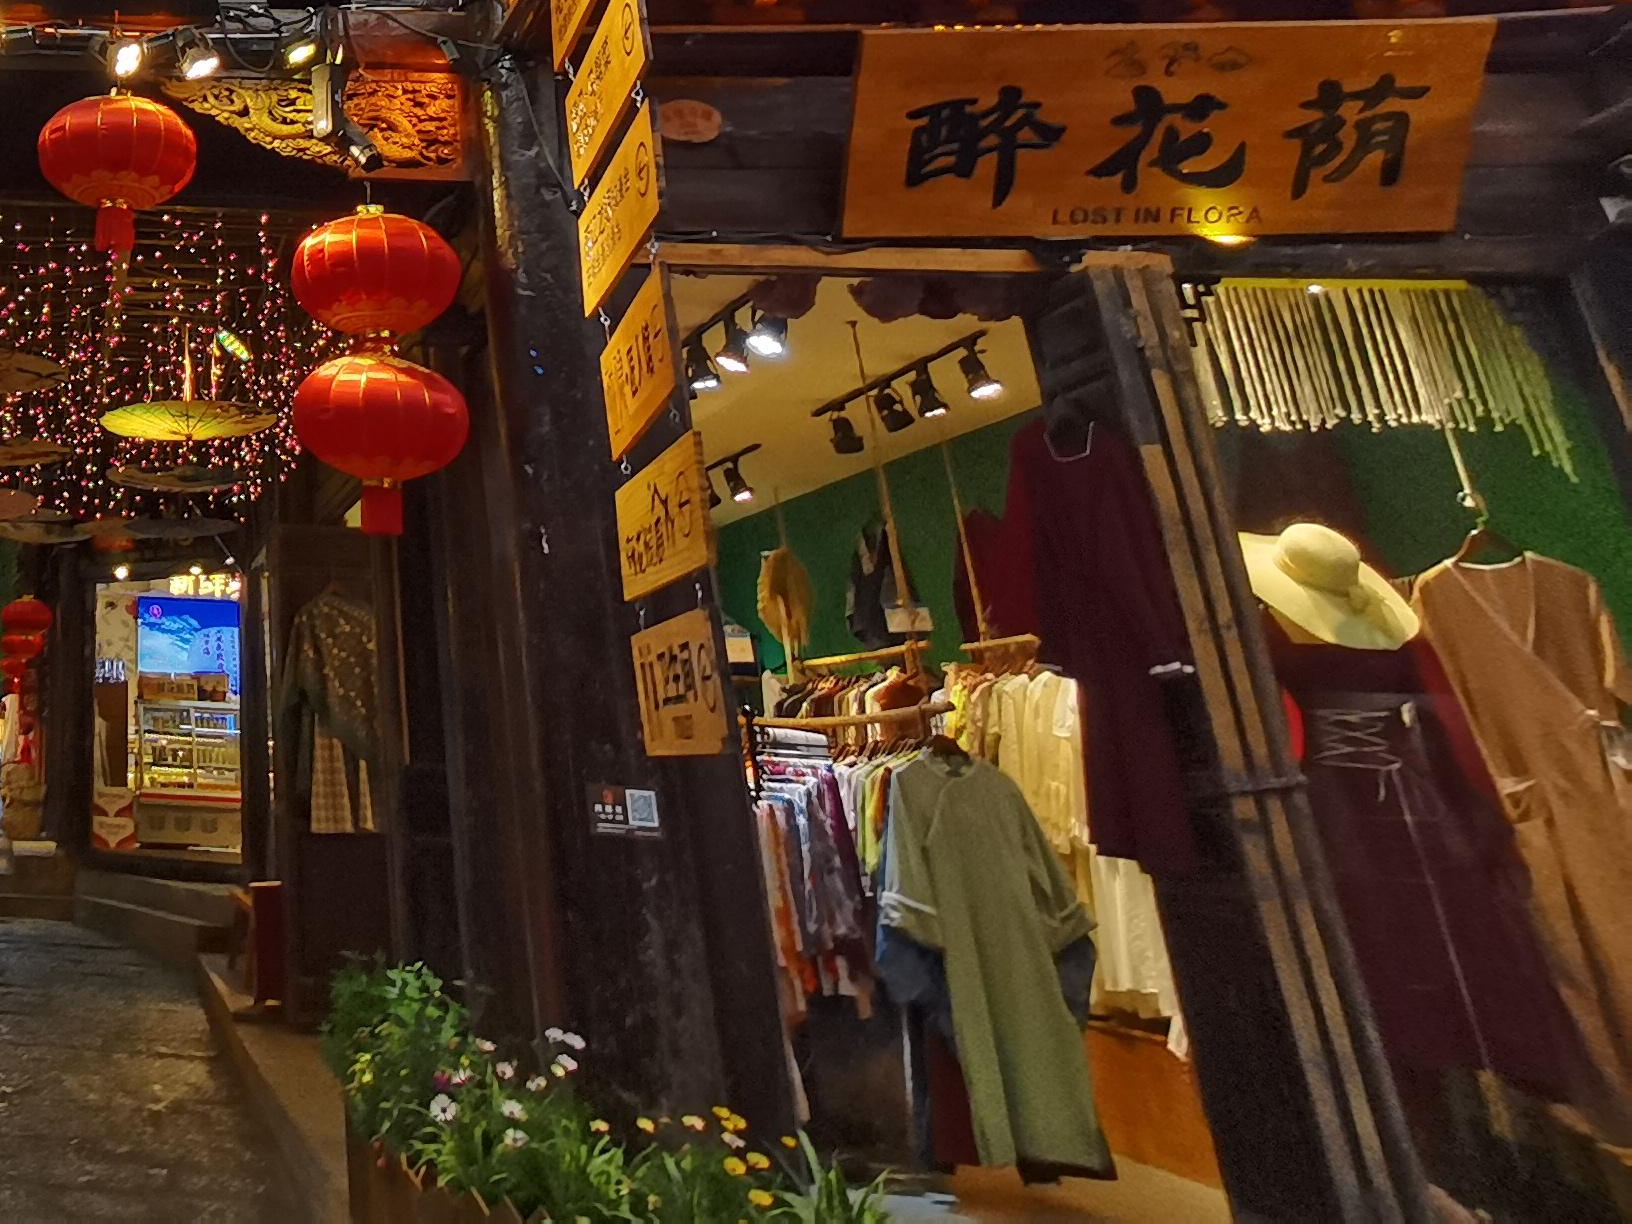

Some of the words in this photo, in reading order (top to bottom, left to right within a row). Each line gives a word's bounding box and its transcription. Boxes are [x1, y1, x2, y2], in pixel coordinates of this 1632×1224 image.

[905, 73, 1431, 209] 醉花荫
[1052, 206, 1126, 226] LOST
[1134, 206, 1161, 224] IN
[1169, 205, 1263, 225] FLORA
